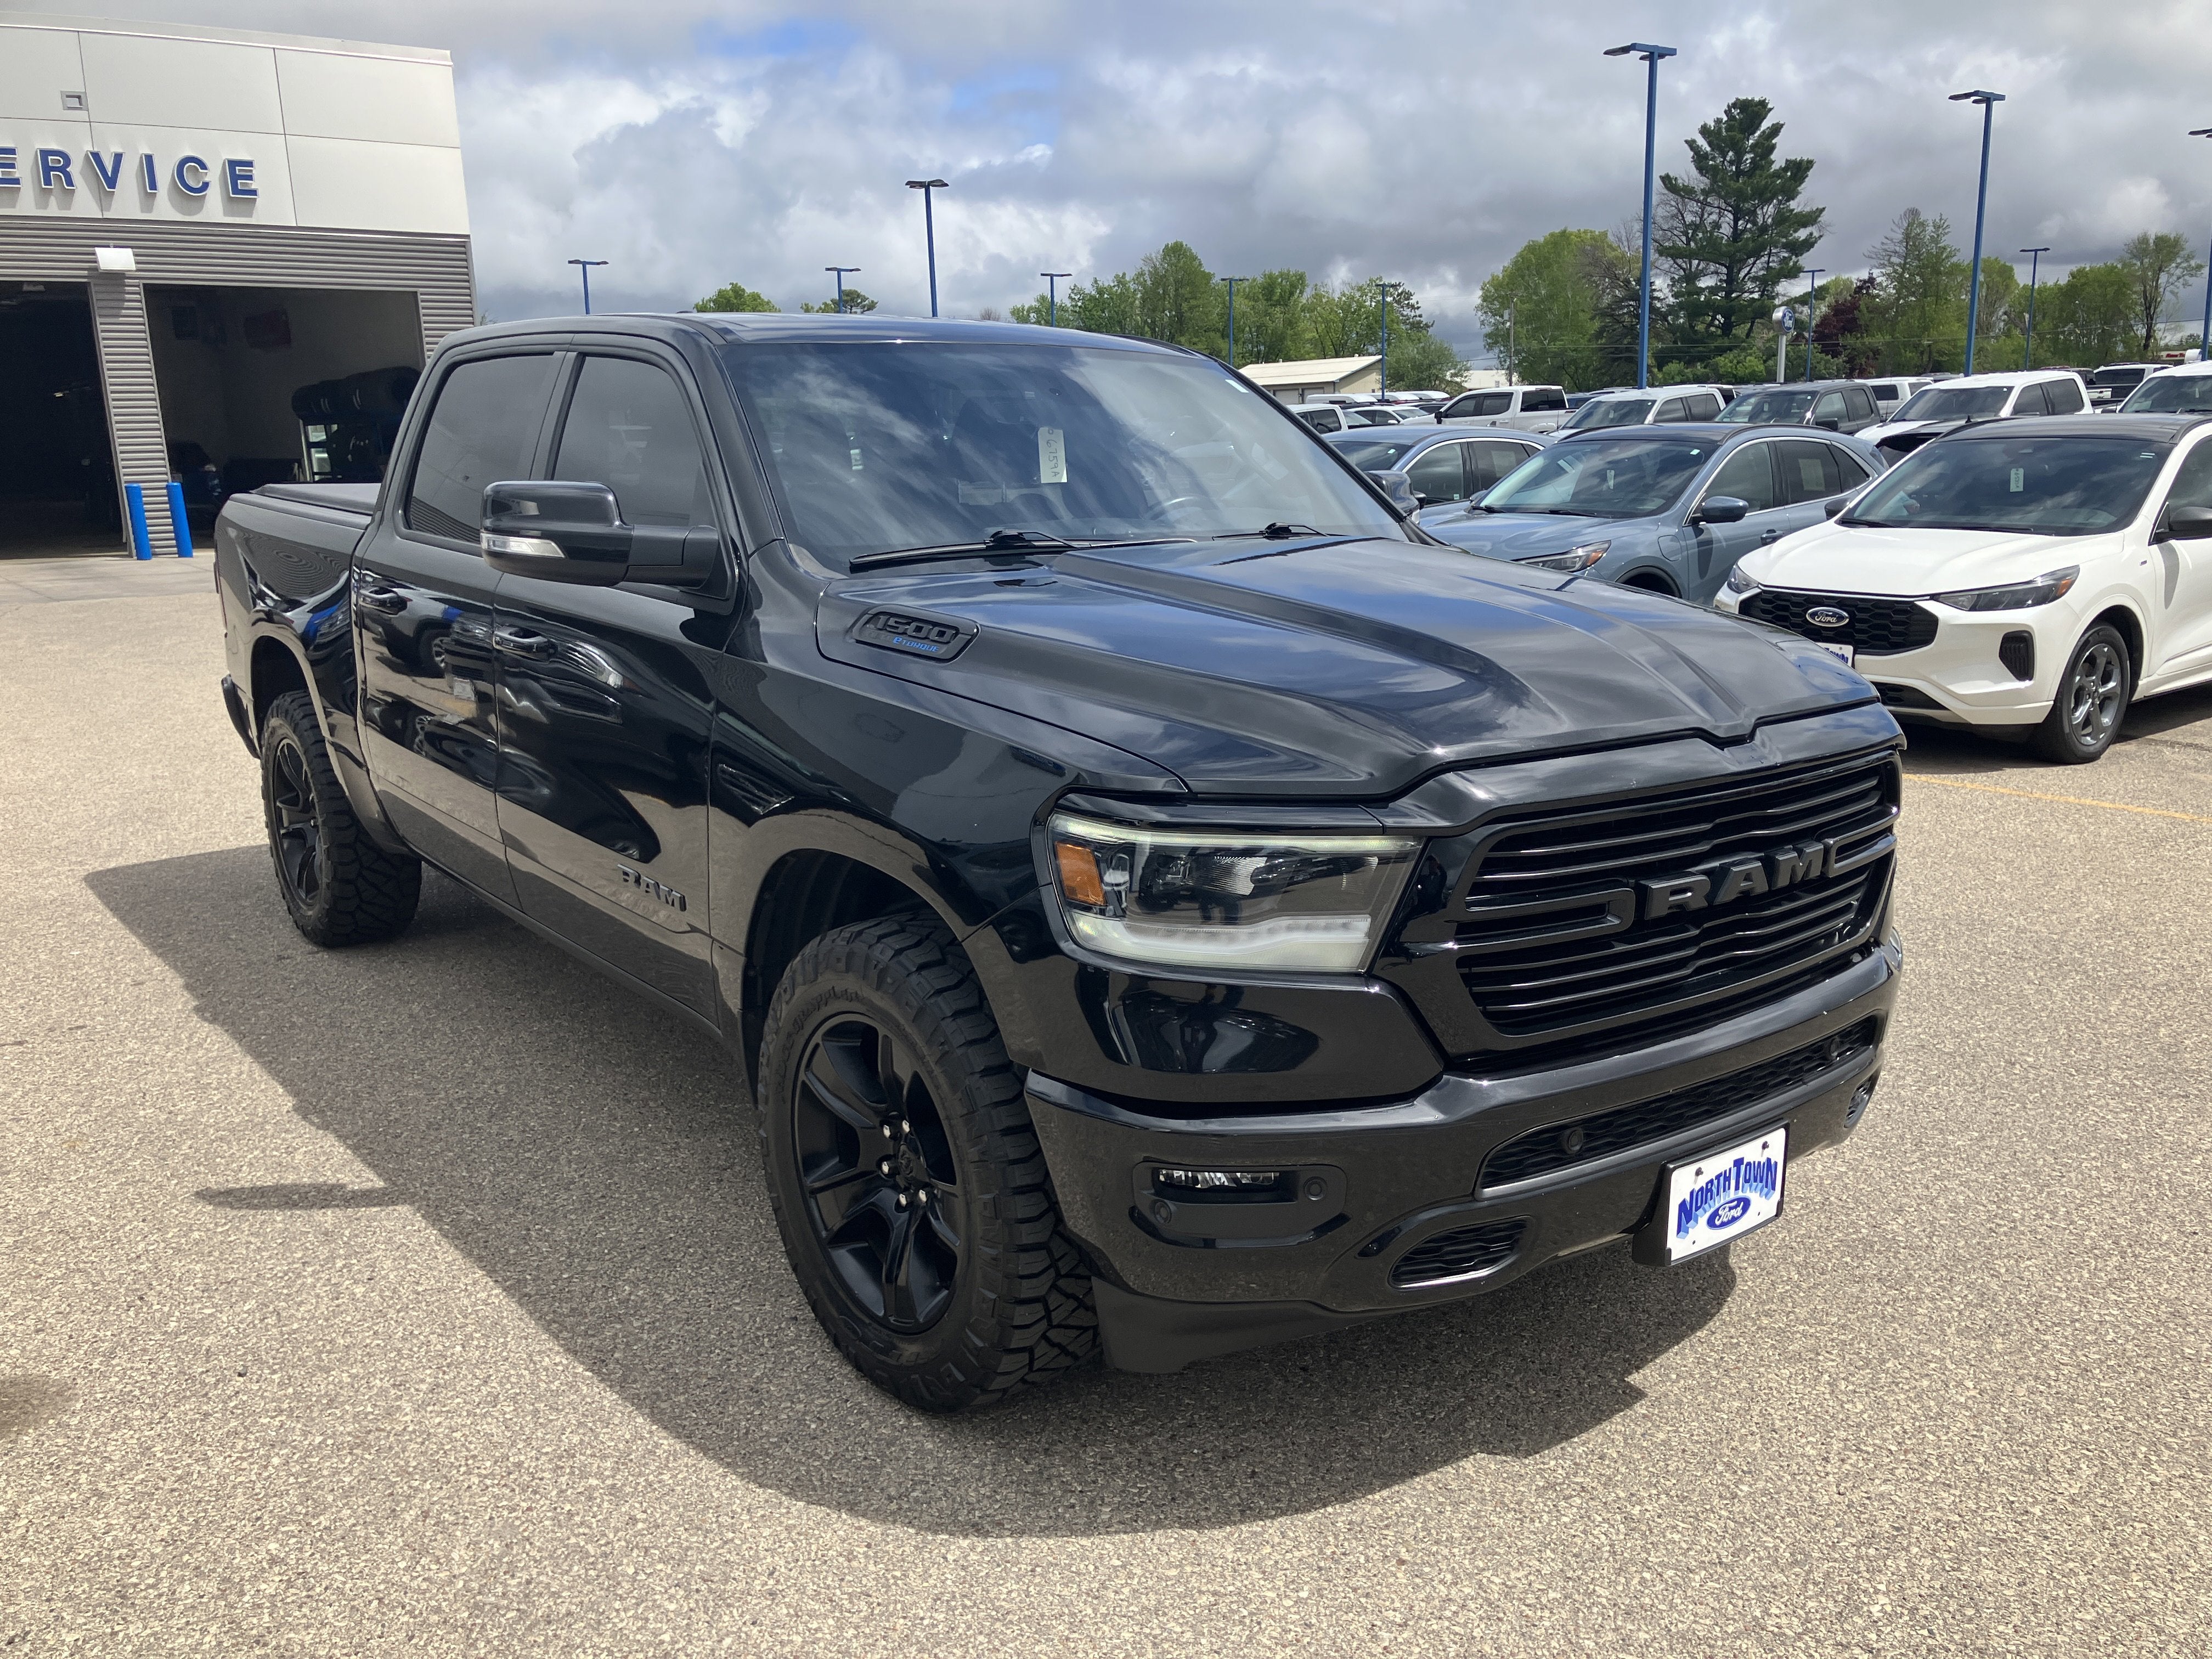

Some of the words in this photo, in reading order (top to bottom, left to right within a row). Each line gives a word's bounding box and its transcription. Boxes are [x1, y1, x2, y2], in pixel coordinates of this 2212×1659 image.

[1046, 439, 1060, 477] 6759A
[876, 615, 954, 643] 1500
[1814, 611, 1838, 624] Ford
[617, 864, 687, 912] RAM
[1645, 840, 1824, 920] RAM
[1715, 1201, 1743, 1226] Ford
